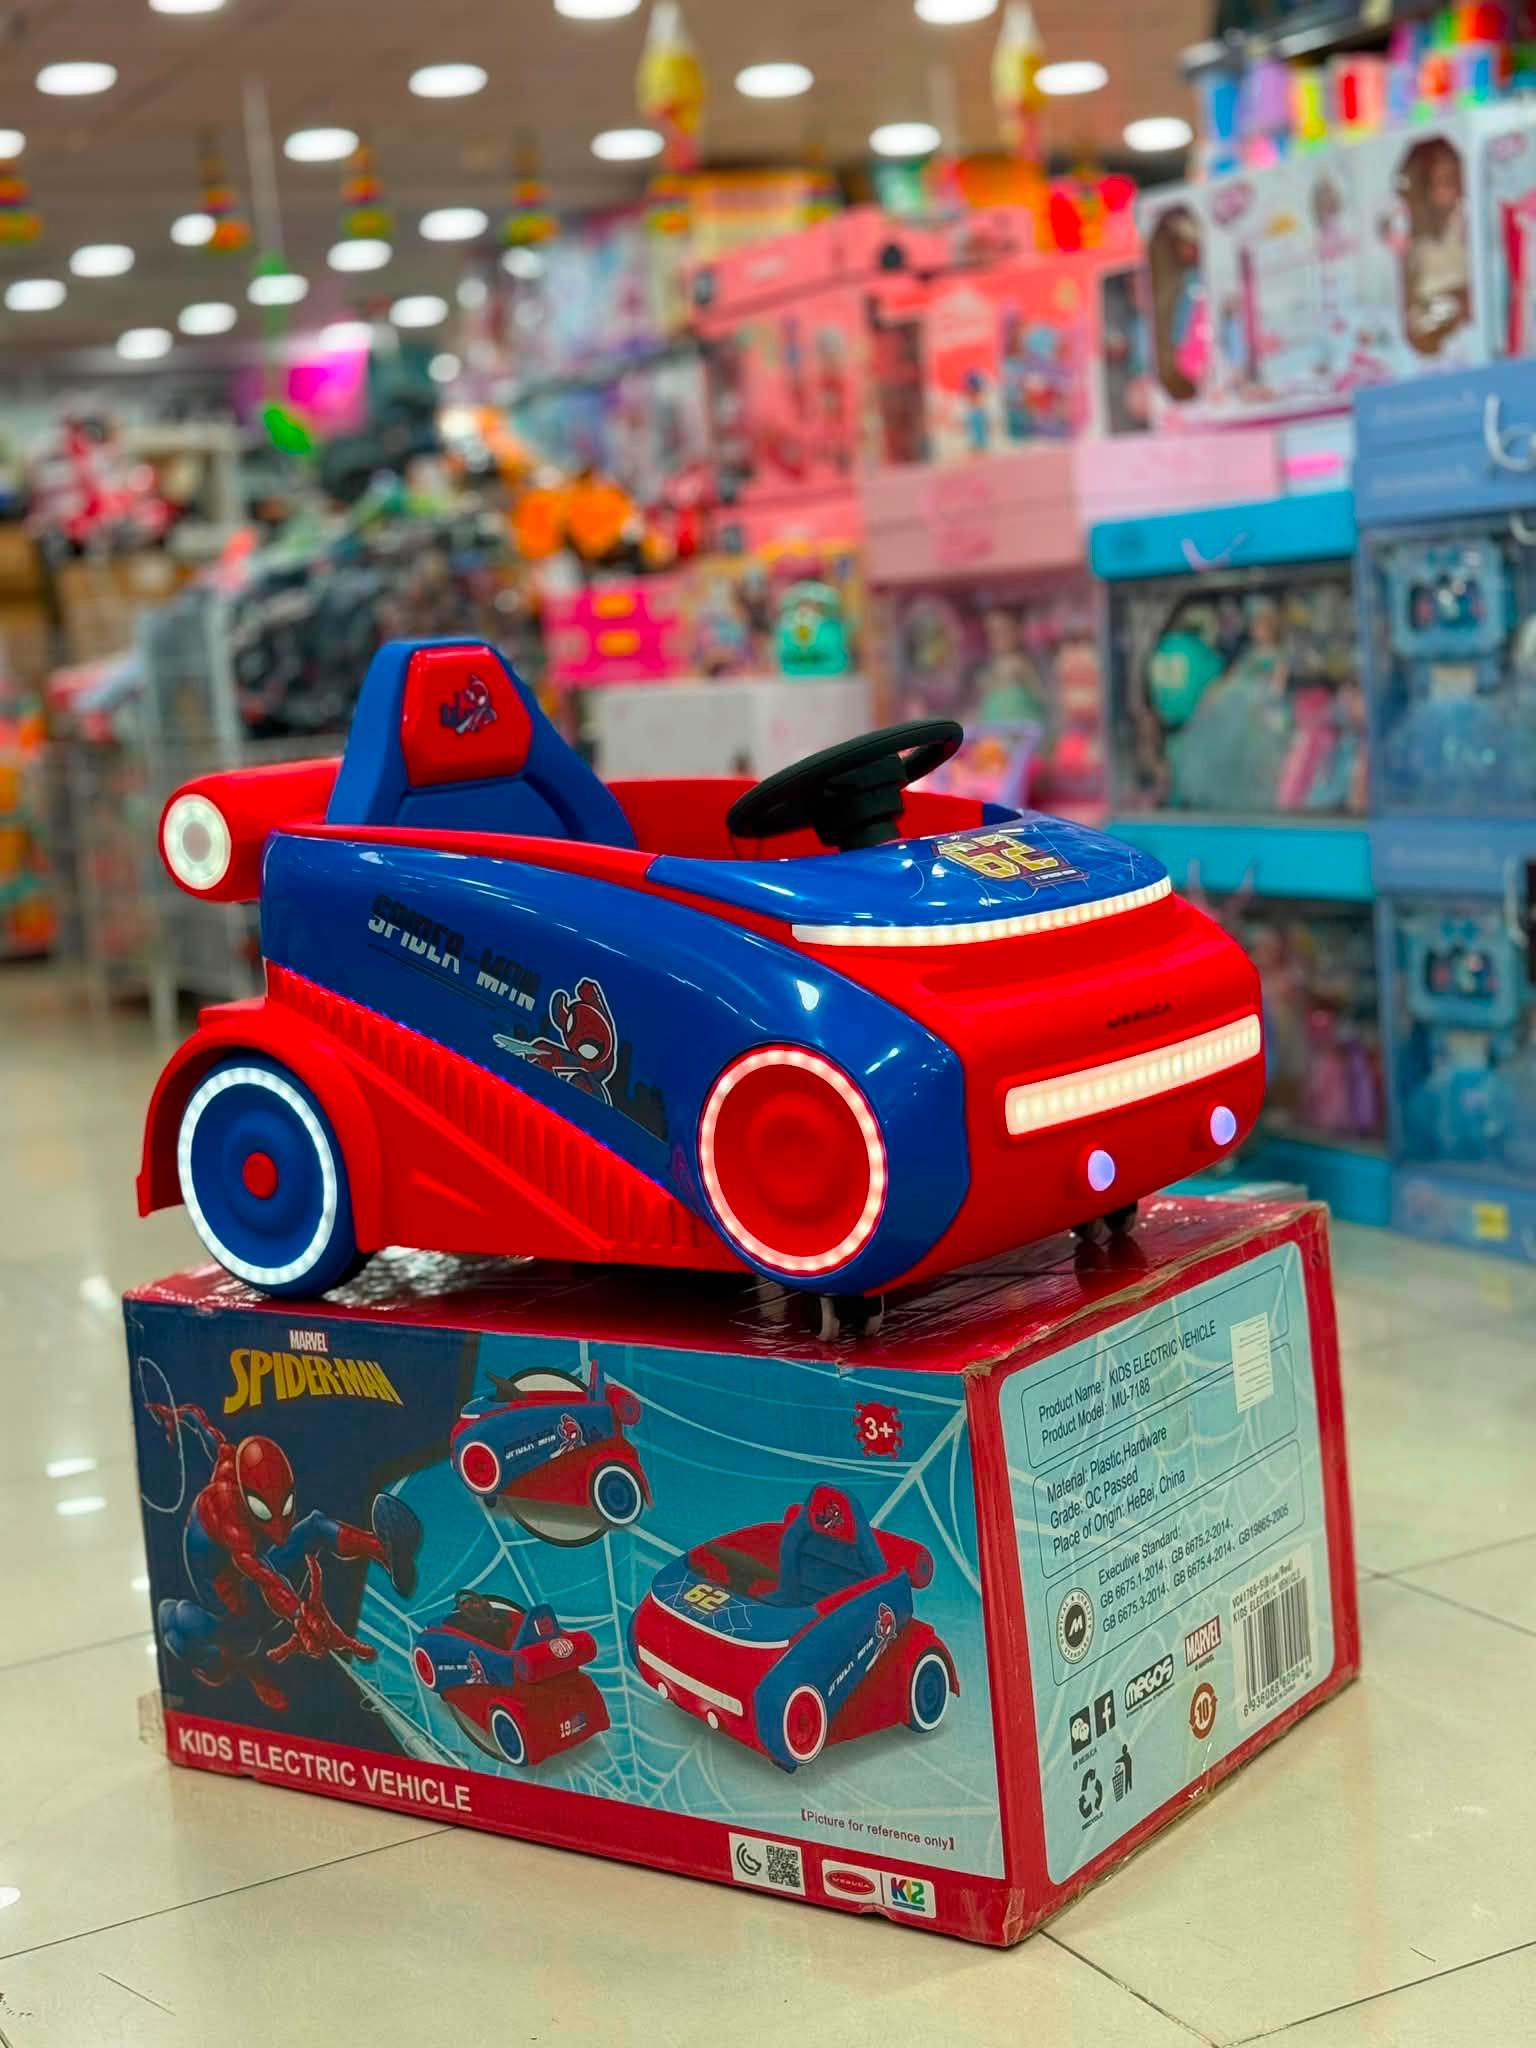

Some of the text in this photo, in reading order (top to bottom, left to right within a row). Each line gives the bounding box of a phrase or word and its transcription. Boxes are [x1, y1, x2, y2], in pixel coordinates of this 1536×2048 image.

[289, 1329, 328, 1352] MARVEL
[223, 1348, 405, 1414] SPIDER-MAN
[1039, 1395, 1073, 1423] Product
[1109, 1362, 1131, 1387] KIDS
[1134, 1341, 1178, 1376] ELECTRIC
[1179, 1320, 1216, 1351] VEHICLE
[864, 1416, 893, 1440] 3+
[1042, 1419, 1076, 1448] Product
[1111, 1377, 1150, 1410] MU-7188
[1047, 1468, 1087, 1505] Material:
[1051, 1466, 1138, 1529] Grade: QC Passed
[1053, 1530, 1080, 1557] Place
[1082, 1520, 1092, 1539] of
[1094, 1503, 1125, 1533] Origin:
[1159, 1468, 1185, 1494] China
[1098, 1527, 1182, 1585] Executive Standard:
[1100, 1592, 1114, 1609] GB
[1171, 1548, 1184, 1564] GB
[684, 1583, 730, 1611] 62
[1103, 1616, 1116, 1633] GB
[1173, 1570, 1186, 1588] GB
[1186, 1618, 1220, 1664] MARVEL
[179, 1727, 472, 1812] KIDS ELECTRIC VEHICLE
[848, 1819, 864, 1833] for
[867, 1824, 921, 1844] reference
